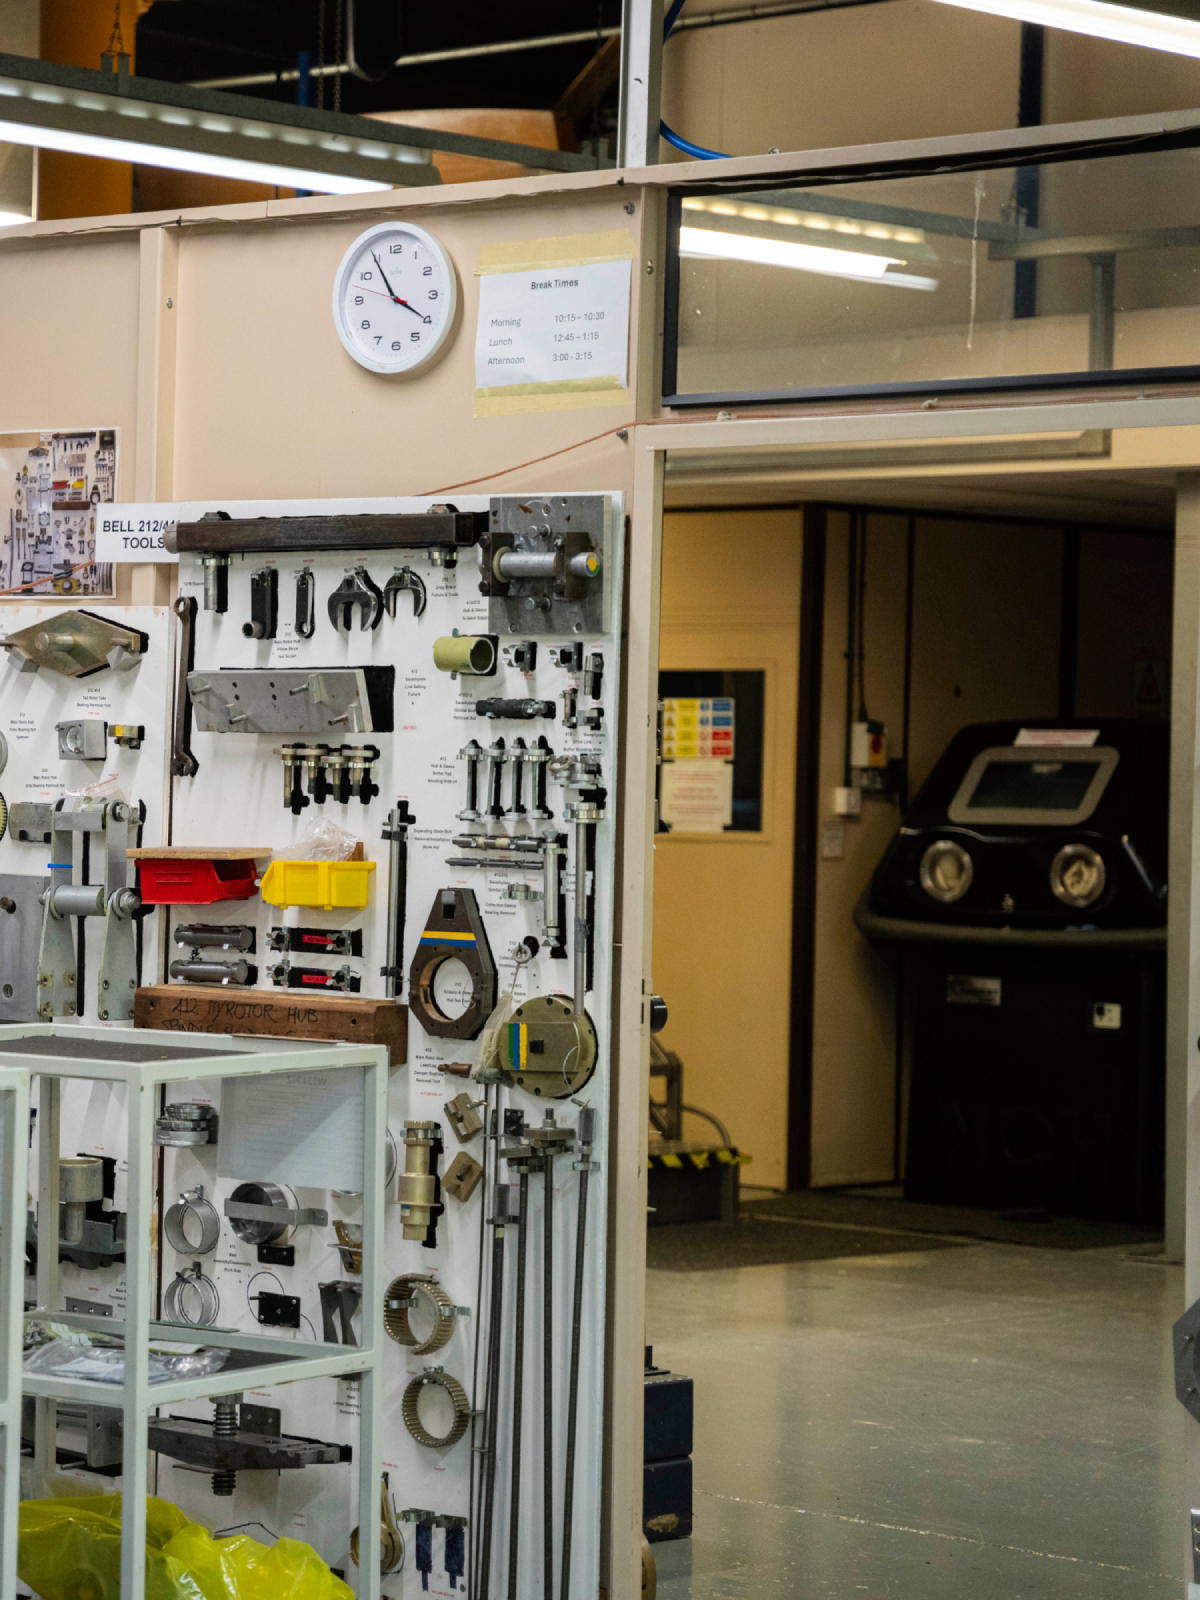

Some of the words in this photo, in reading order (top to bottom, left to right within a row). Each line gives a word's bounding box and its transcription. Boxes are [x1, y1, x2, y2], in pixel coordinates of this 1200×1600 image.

[390, 244, 402, 254] 12
[423, 266, 432, 276] 2
[360, 272, 372, 281] 10
[531, 280, 553, 290] Break
[554, 279, 579, 289] Times
[428, 290, 438, 300] 3
[354, 296, 364, 305] 9
[361, 320, 370, 329] 8
[423, 315, 432, 324] 4
[490, 318, 521, 328] Morning
[554, 313, 576, 323] 10:15
[584, 311, 605, 321] 10:30
[373, 336, 382, 345] 7
[410, 332, 420, 342] 5
[489, 338, 513, 347] Lunch
[553, 333, 575, 343] 12:45
[582, 331, 599, 341] 1:15
[391, 341, 401, 351] 6
[487, 356, 525, 366] Afternoon
[553, 353, 569, 362] 3:00
[575, 352, 593, 361] 3:15
[103, 520, 135, 532] BELL
[122, 537, 165, 549] TOOLS
[172, 997, 199, 1016] 412
[287, 1007, 318, 1024] HUB
